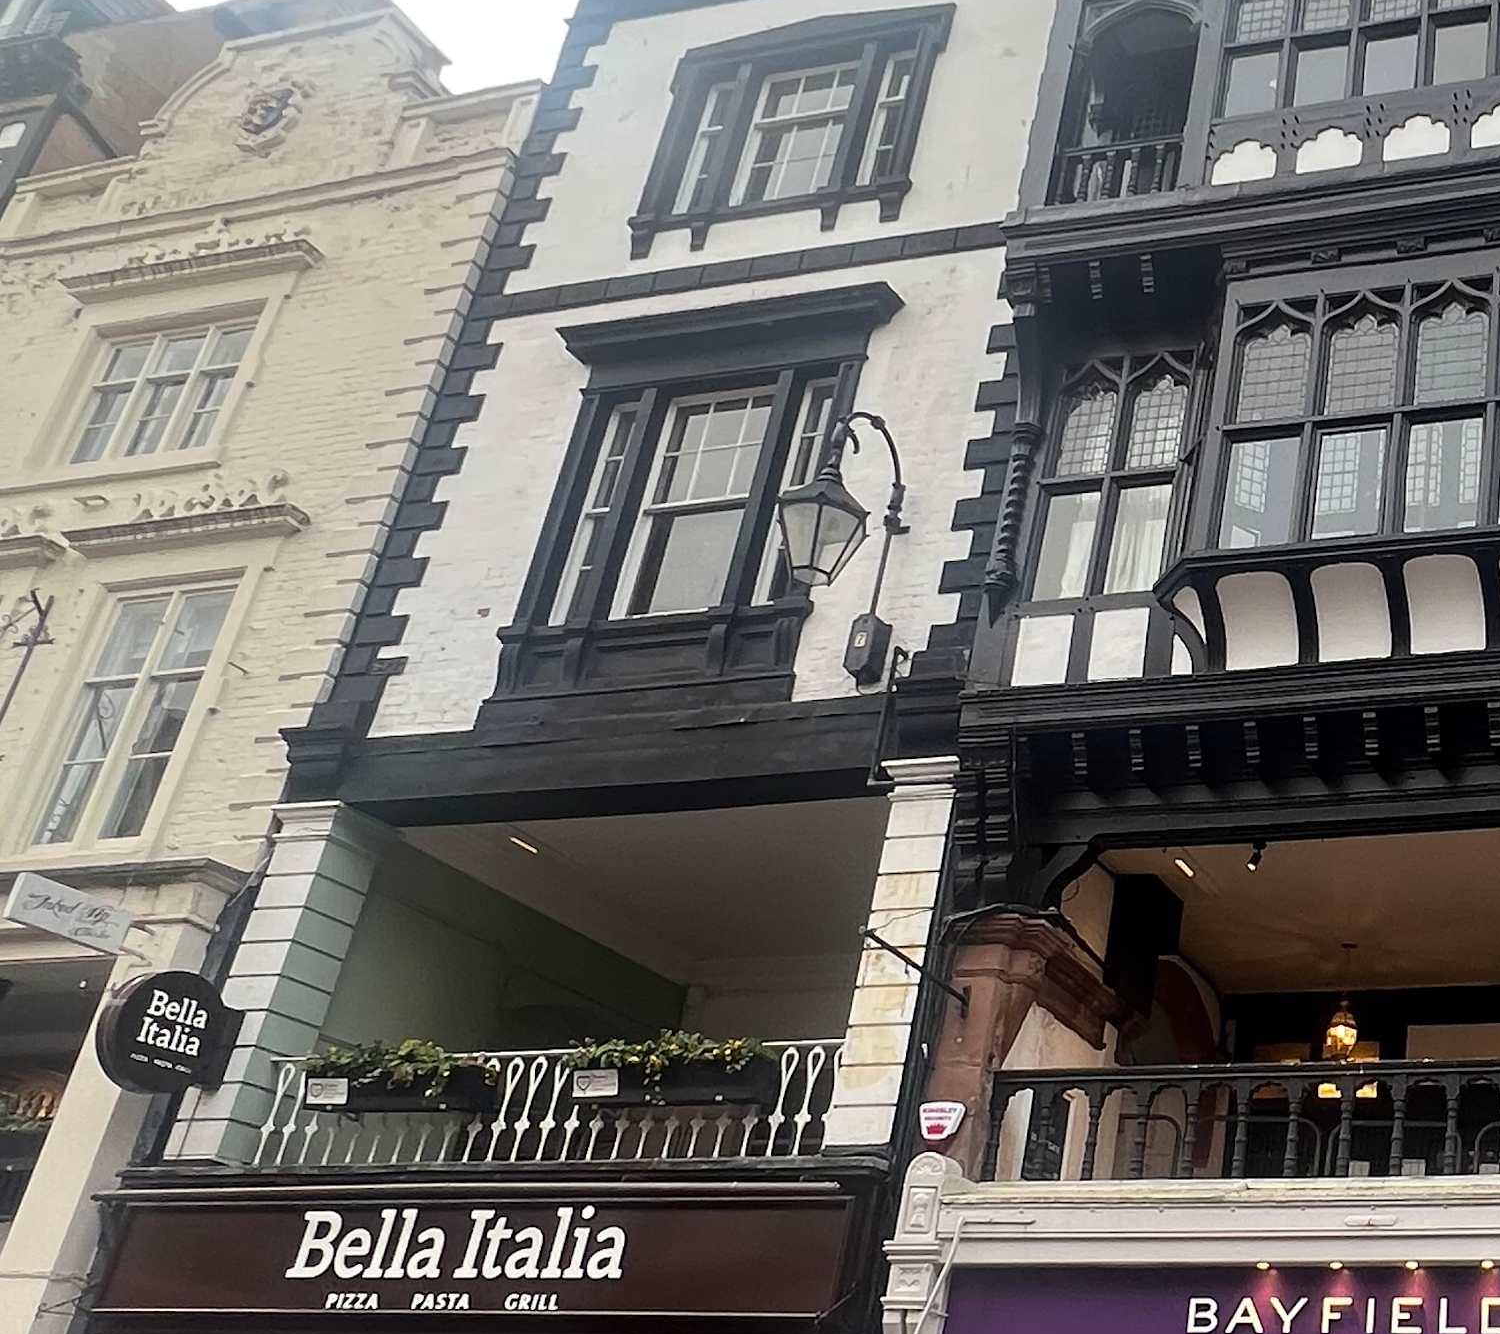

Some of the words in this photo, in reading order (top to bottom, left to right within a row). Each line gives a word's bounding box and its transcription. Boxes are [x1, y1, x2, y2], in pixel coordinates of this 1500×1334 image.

[146, 988, 208, 1029] Bella
[136, 1016, 201, 1056] Italia
[285, 1208, 447, 1279] Bella
[452, 1205, 627, 1280] Italia
[325, 1293, 379, 1310] PIZZA
[410, 1293, 470, 1311] PASTA
[504, 1293, 560, 1311] GRILL
